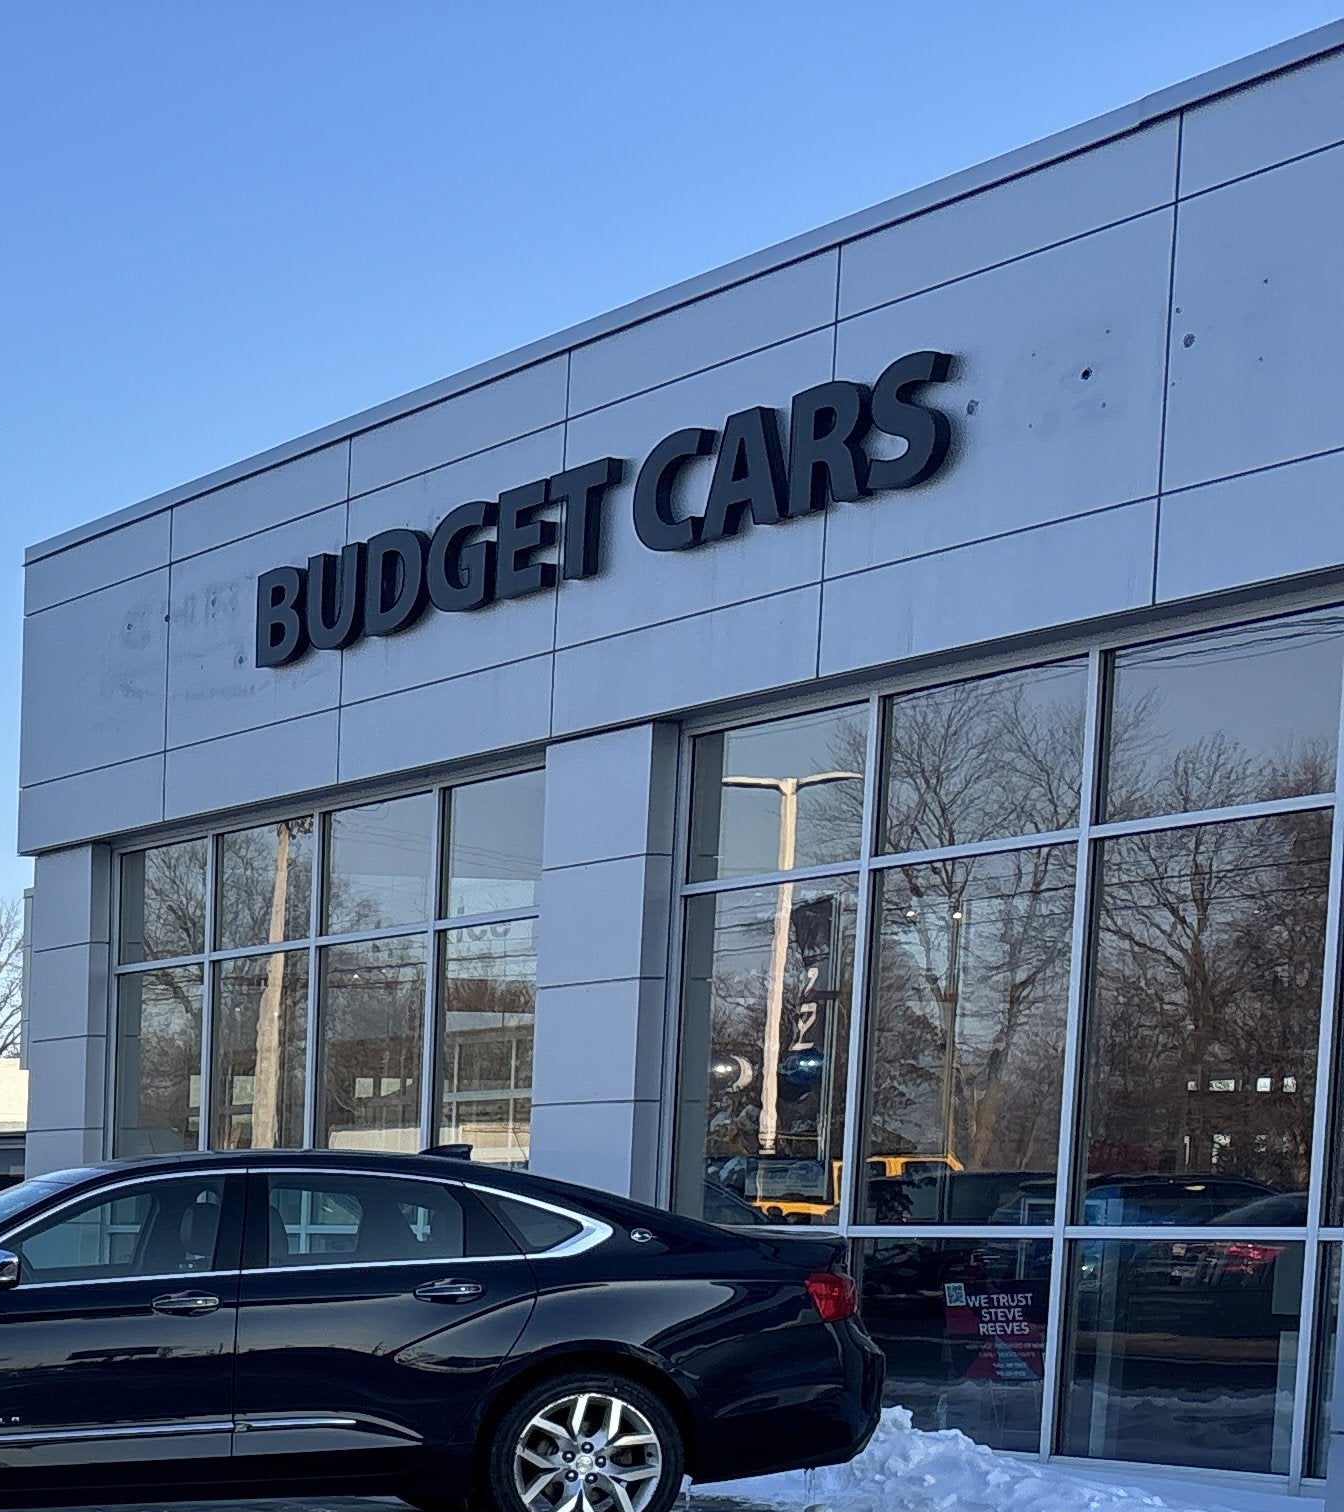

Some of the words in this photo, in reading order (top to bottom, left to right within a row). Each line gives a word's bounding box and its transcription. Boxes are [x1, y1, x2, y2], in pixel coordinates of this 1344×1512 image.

[256, 456, 624, 668] BUDGET
[633, 350, 953, 552] CARS
[966, 1295, 989, 1307] WE
[990, 1292, 1033, 1307] TRUST
[981, 1308, 1024, 1321] STEVE
[979, 1322, 1030, 1335] REEVES
